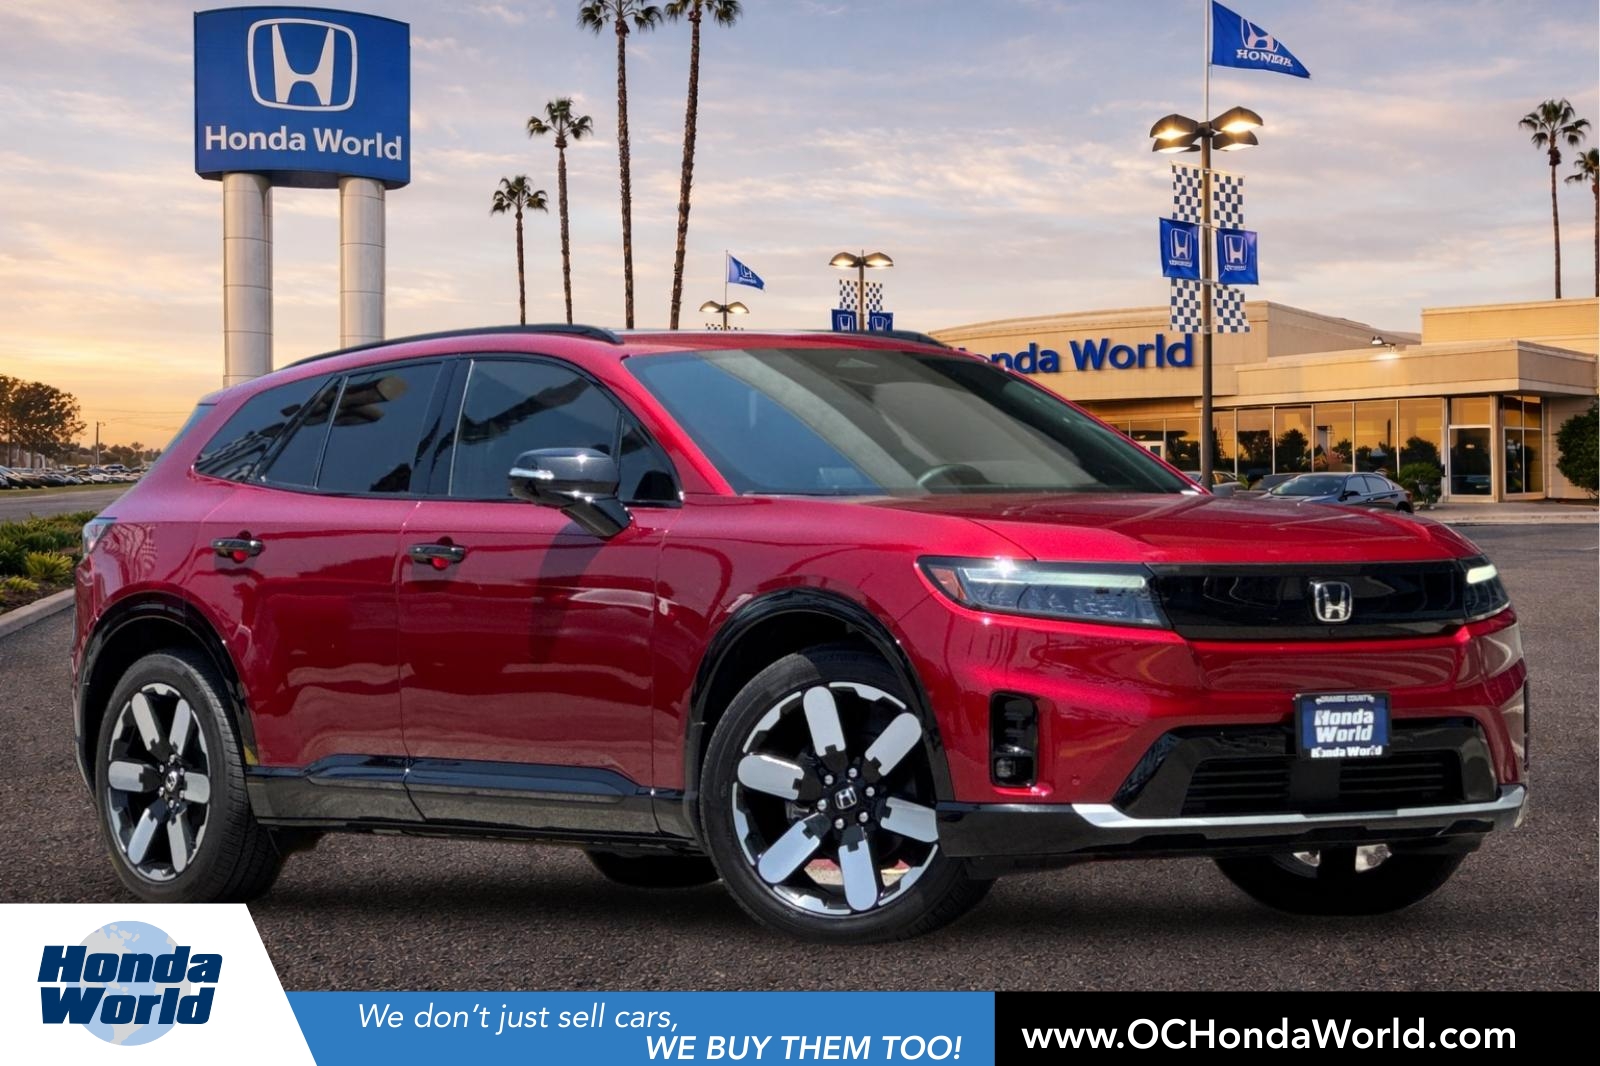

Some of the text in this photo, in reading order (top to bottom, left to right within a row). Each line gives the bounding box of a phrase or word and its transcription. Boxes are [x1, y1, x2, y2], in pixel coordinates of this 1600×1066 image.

[205, 125, 402, 161] Honda World
[958, 333, 1193, 373] nda World
[1314, 708, 1374, 726] Honda
[1316, 724, 1374, 743] World
